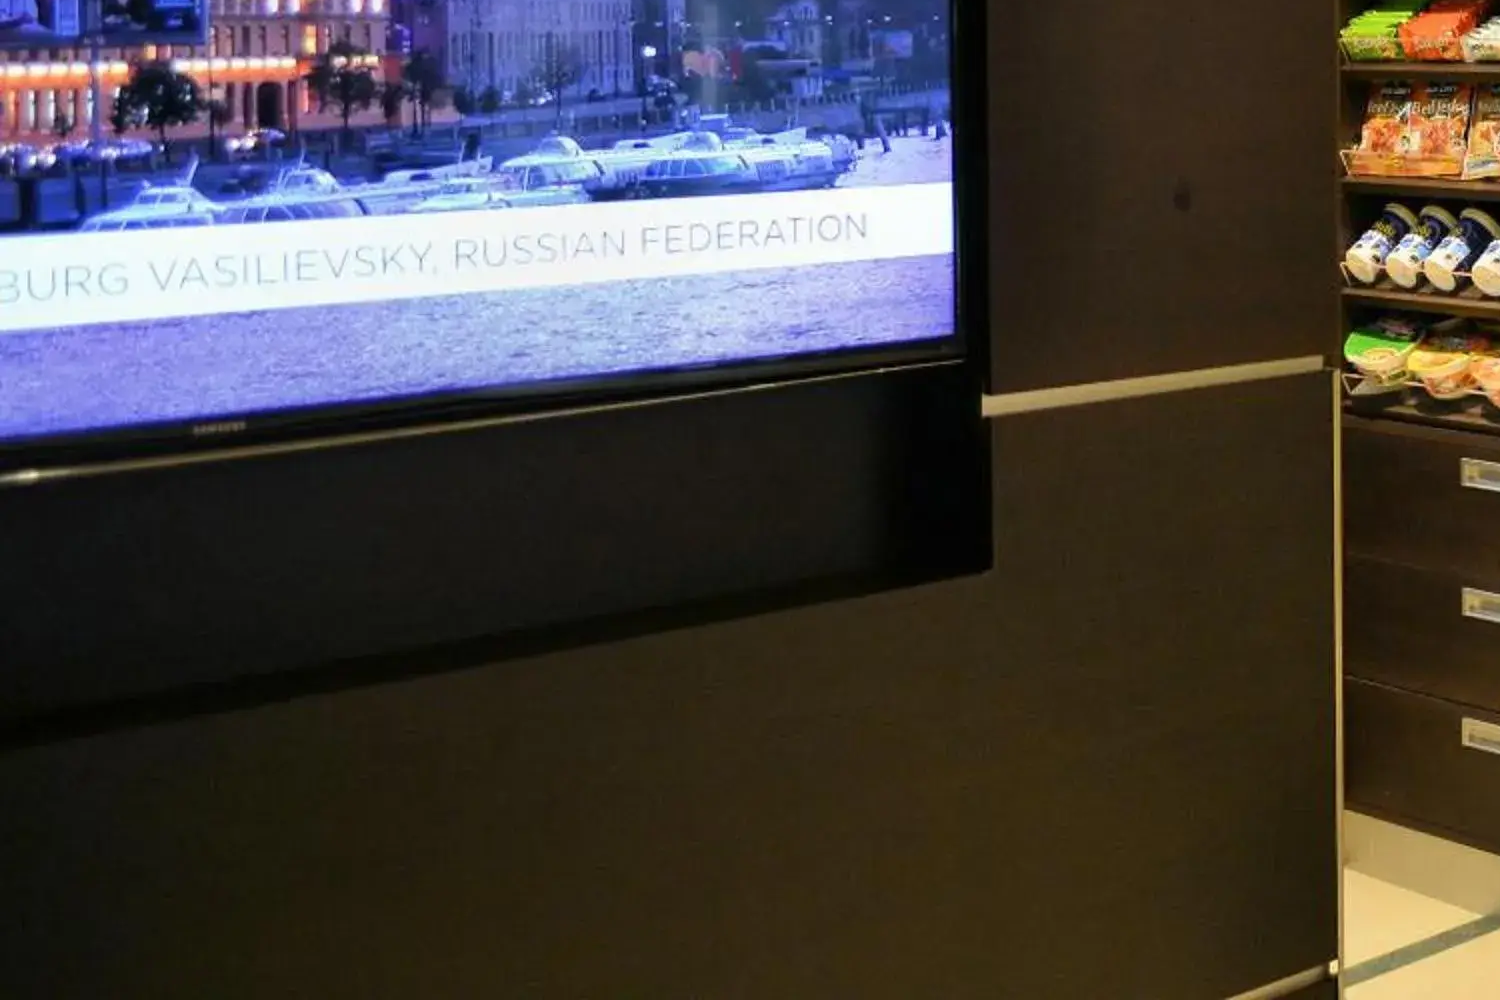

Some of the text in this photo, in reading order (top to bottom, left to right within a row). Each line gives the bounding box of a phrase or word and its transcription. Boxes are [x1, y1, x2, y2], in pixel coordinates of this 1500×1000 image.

[0, 261, 130, 304] BURG
[454, 228, 626, 271] RUSSIAN
[640, 212, 869, 255] FEDERATION
